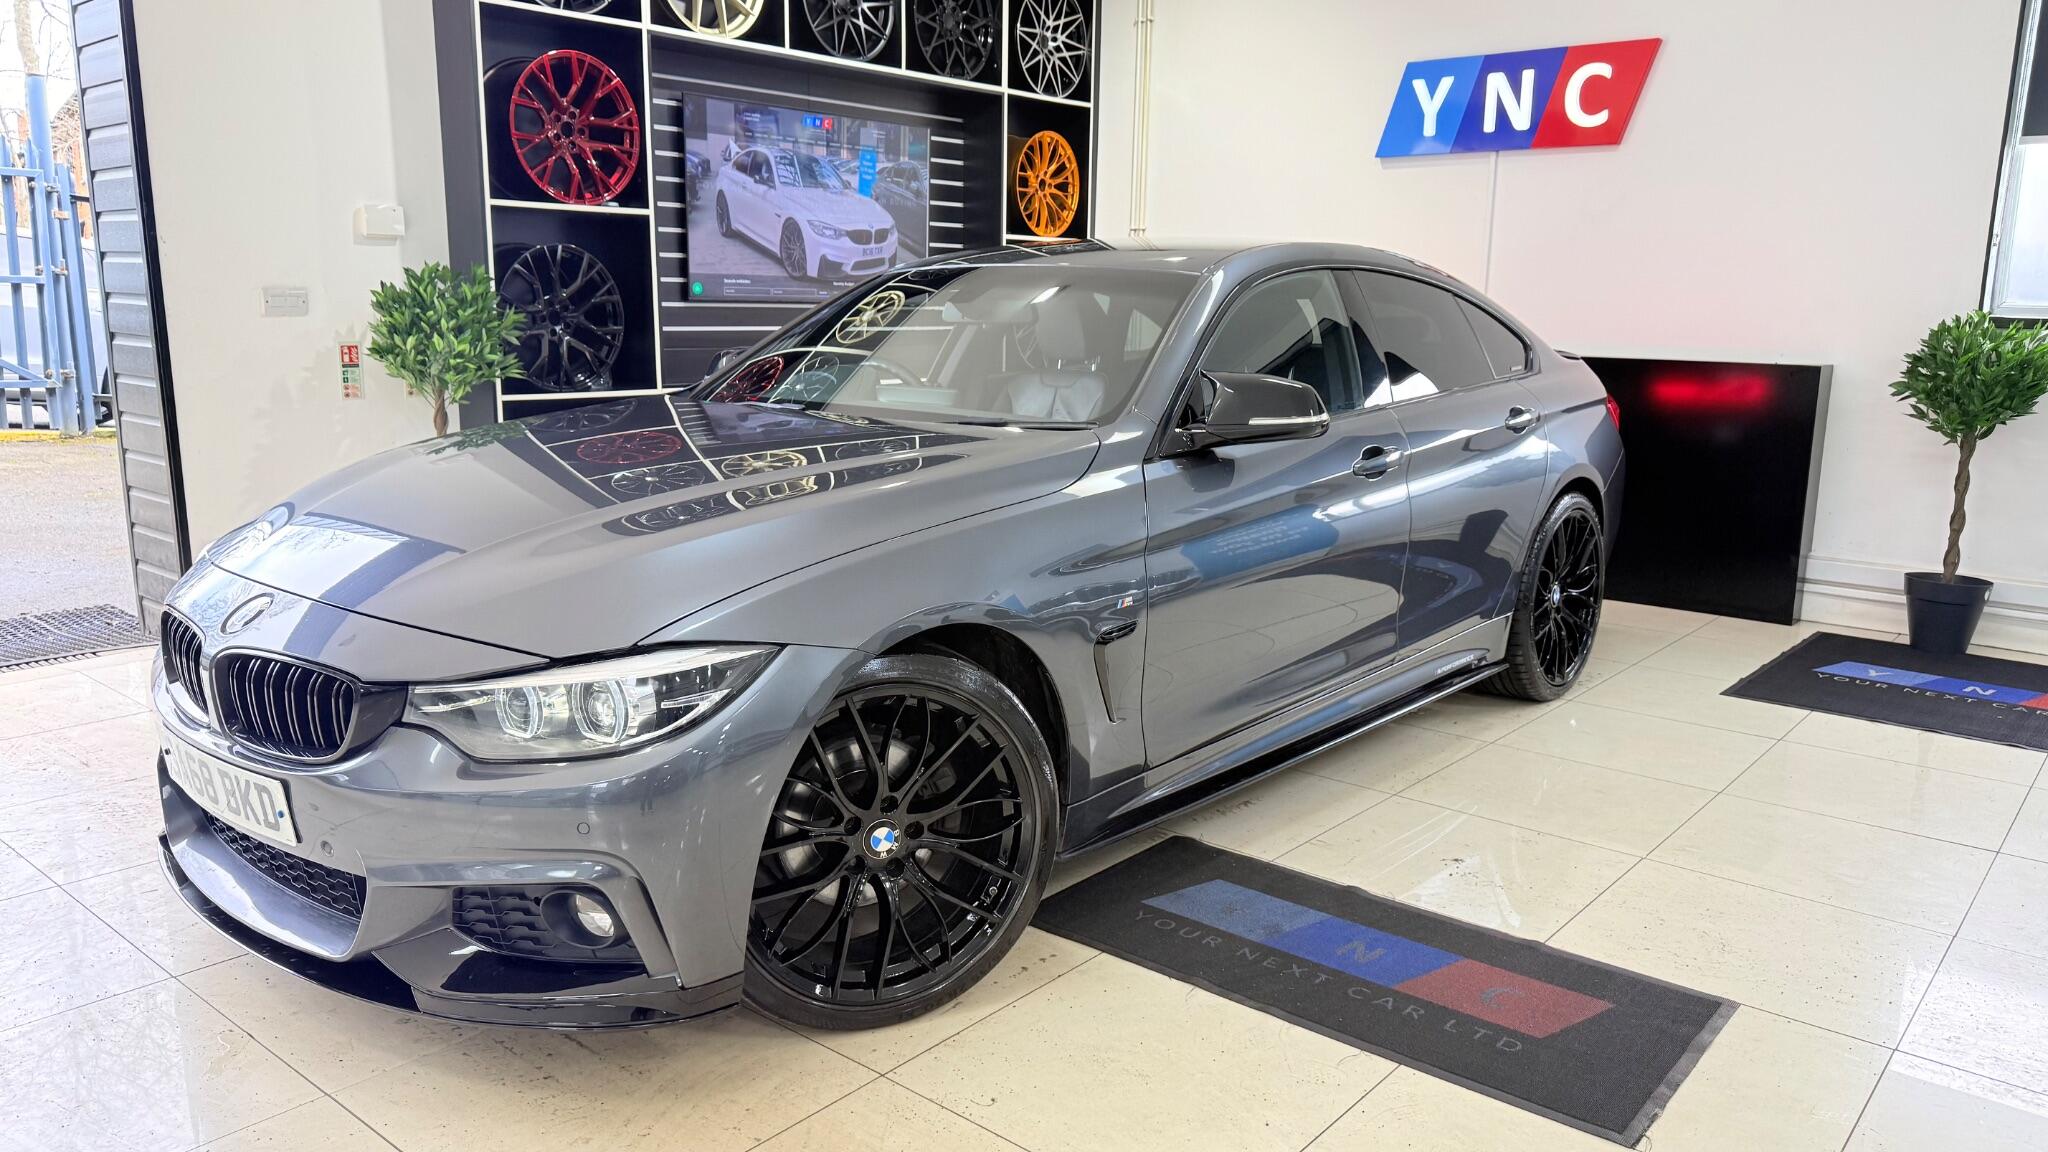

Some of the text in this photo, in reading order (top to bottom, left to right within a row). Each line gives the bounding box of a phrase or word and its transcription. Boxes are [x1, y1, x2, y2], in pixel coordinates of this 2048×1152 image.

[1411, 61, 1613, 137] YNC
[1816, 672, 1889, 689] YOUR
[1903, 687, 1979, 704] NEXT
[217, 767, 281, 832] BKD
[1135, 911, 1523, 1052] YOUR NEXT CAR LTD
